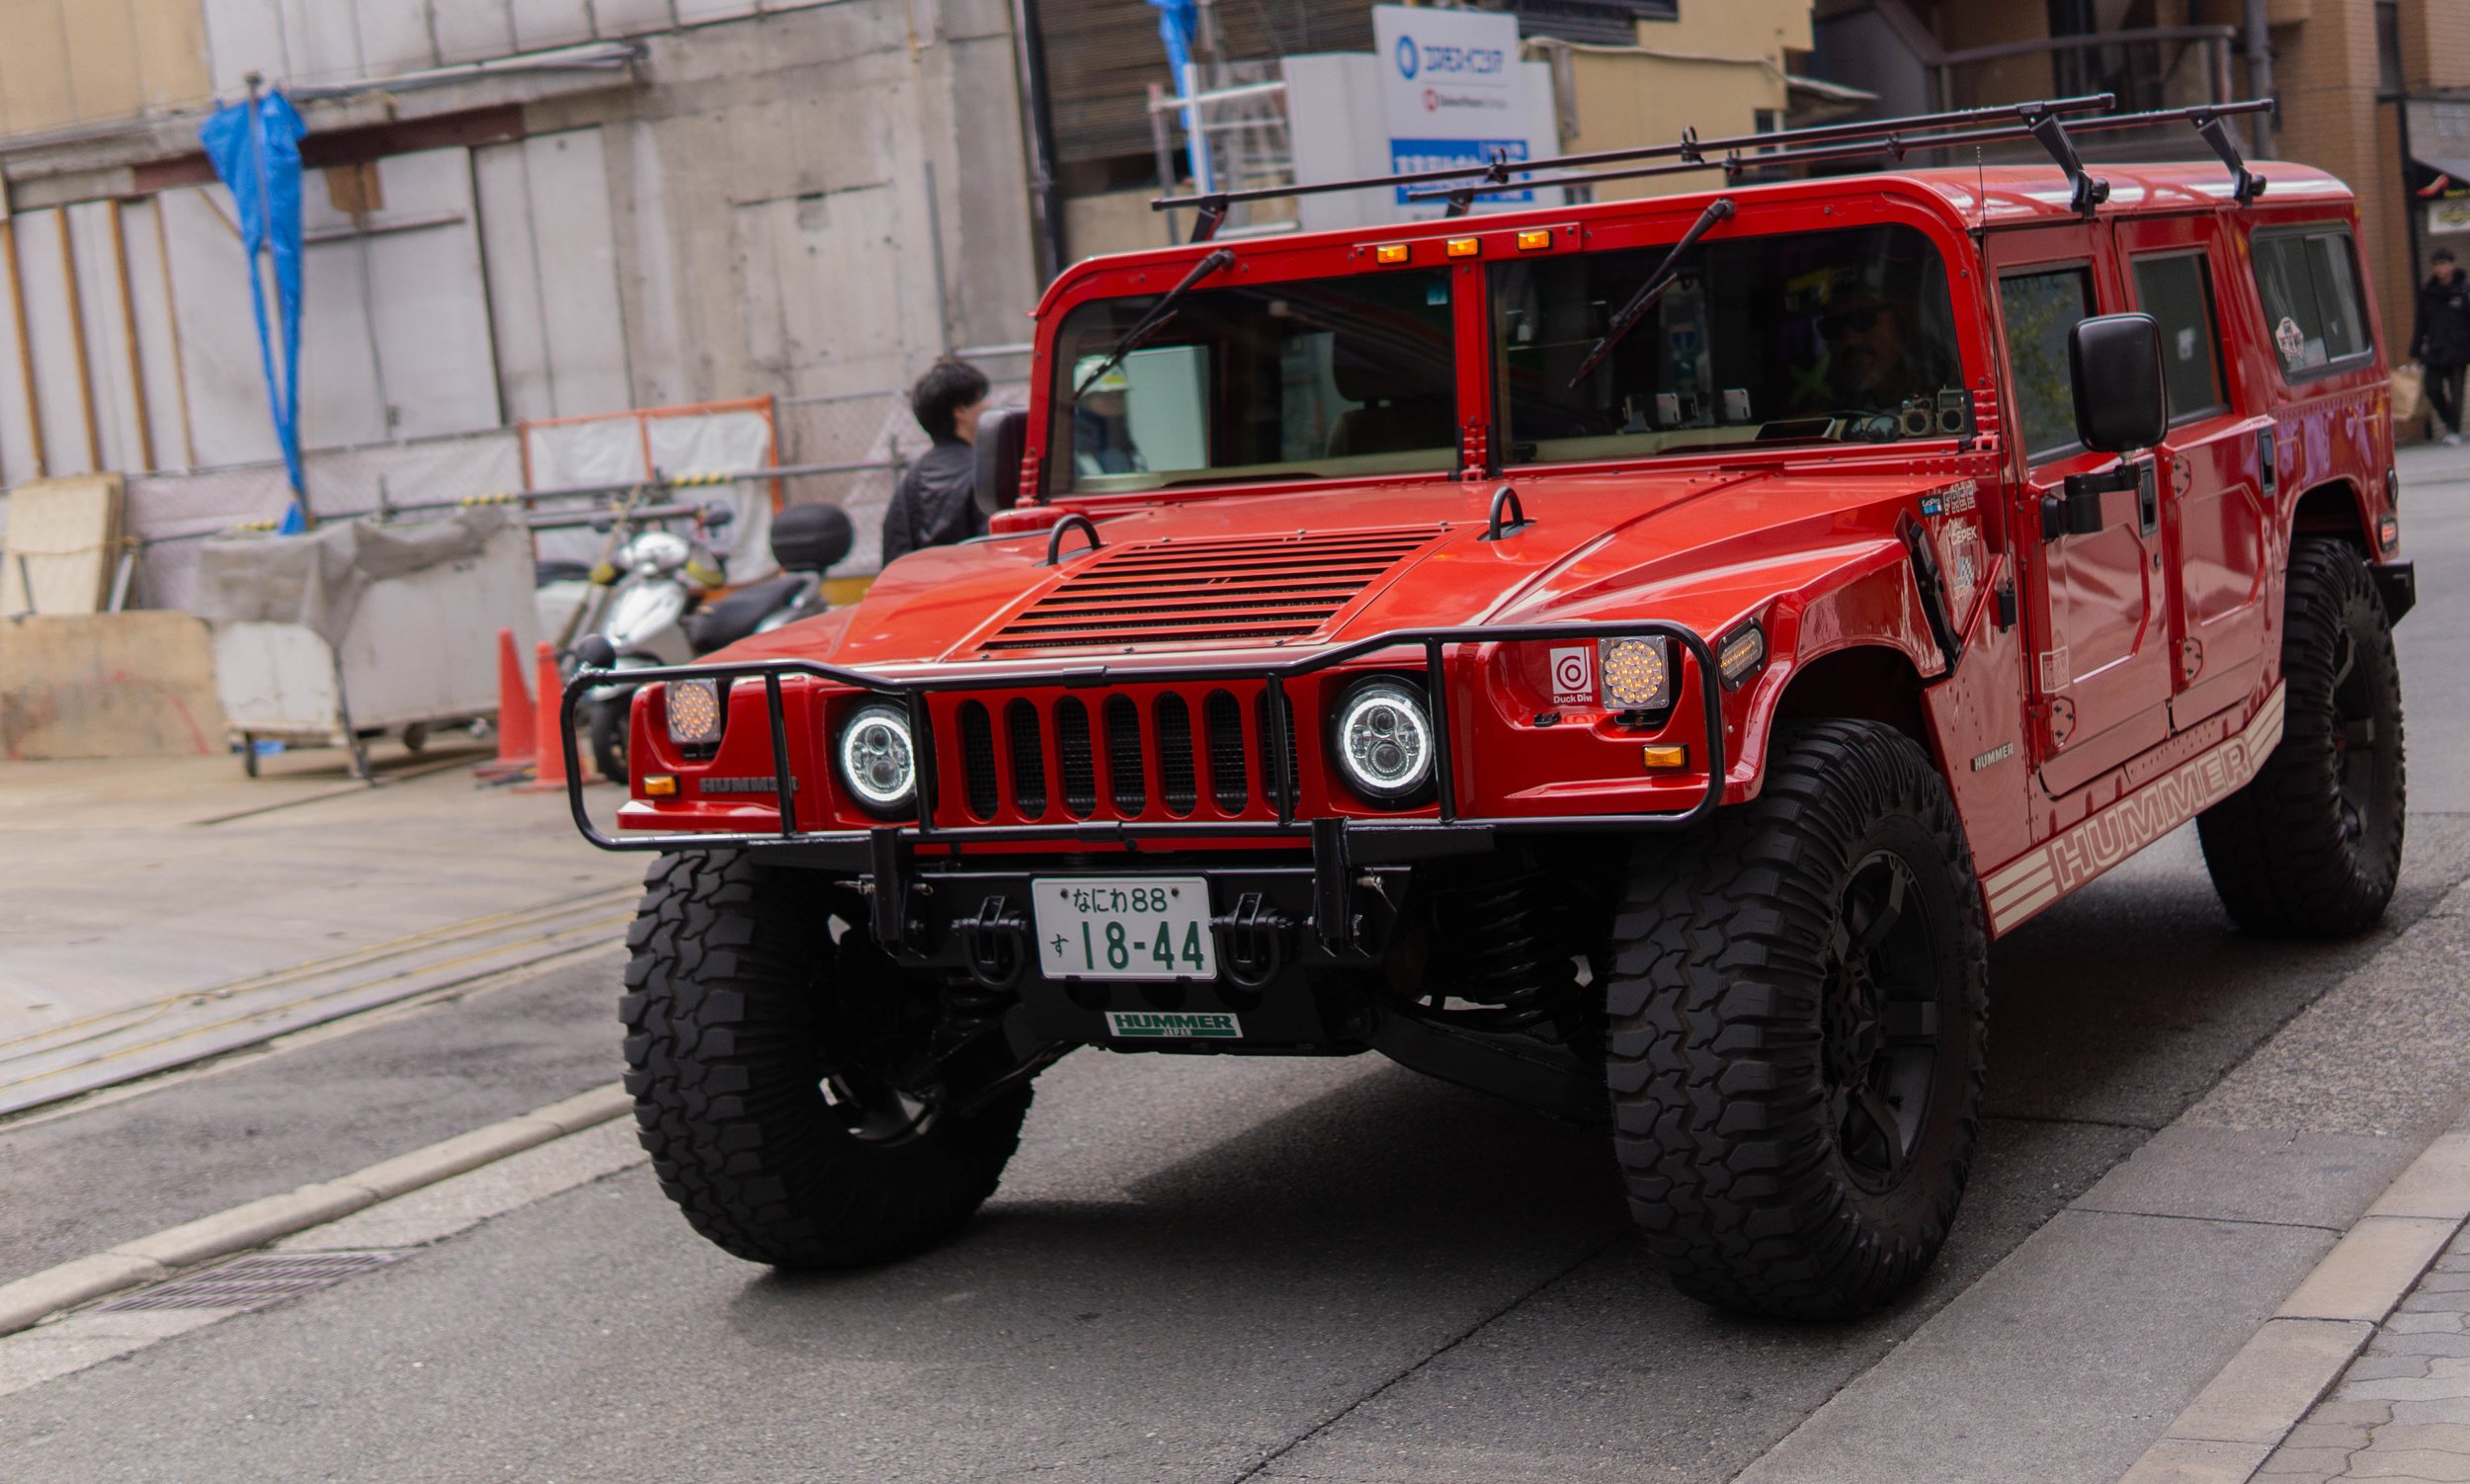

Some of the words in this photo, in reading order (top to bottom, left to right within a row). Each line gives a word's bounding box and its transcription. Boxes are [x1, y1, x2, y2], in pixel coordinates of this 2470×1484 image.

[1922, 498, 1941, 508] GoPro
[1951, 525, 1977, 545] CEPEK
[1974, 742, 2014, 771] HUMMER
[2051, 737, 2252, 892] HUMMER
[1050, 934, 1069, 958] す
[1082, 921, 1204, 970] 18-44
[1112, 1014, 1234, 1029] HUMMER
